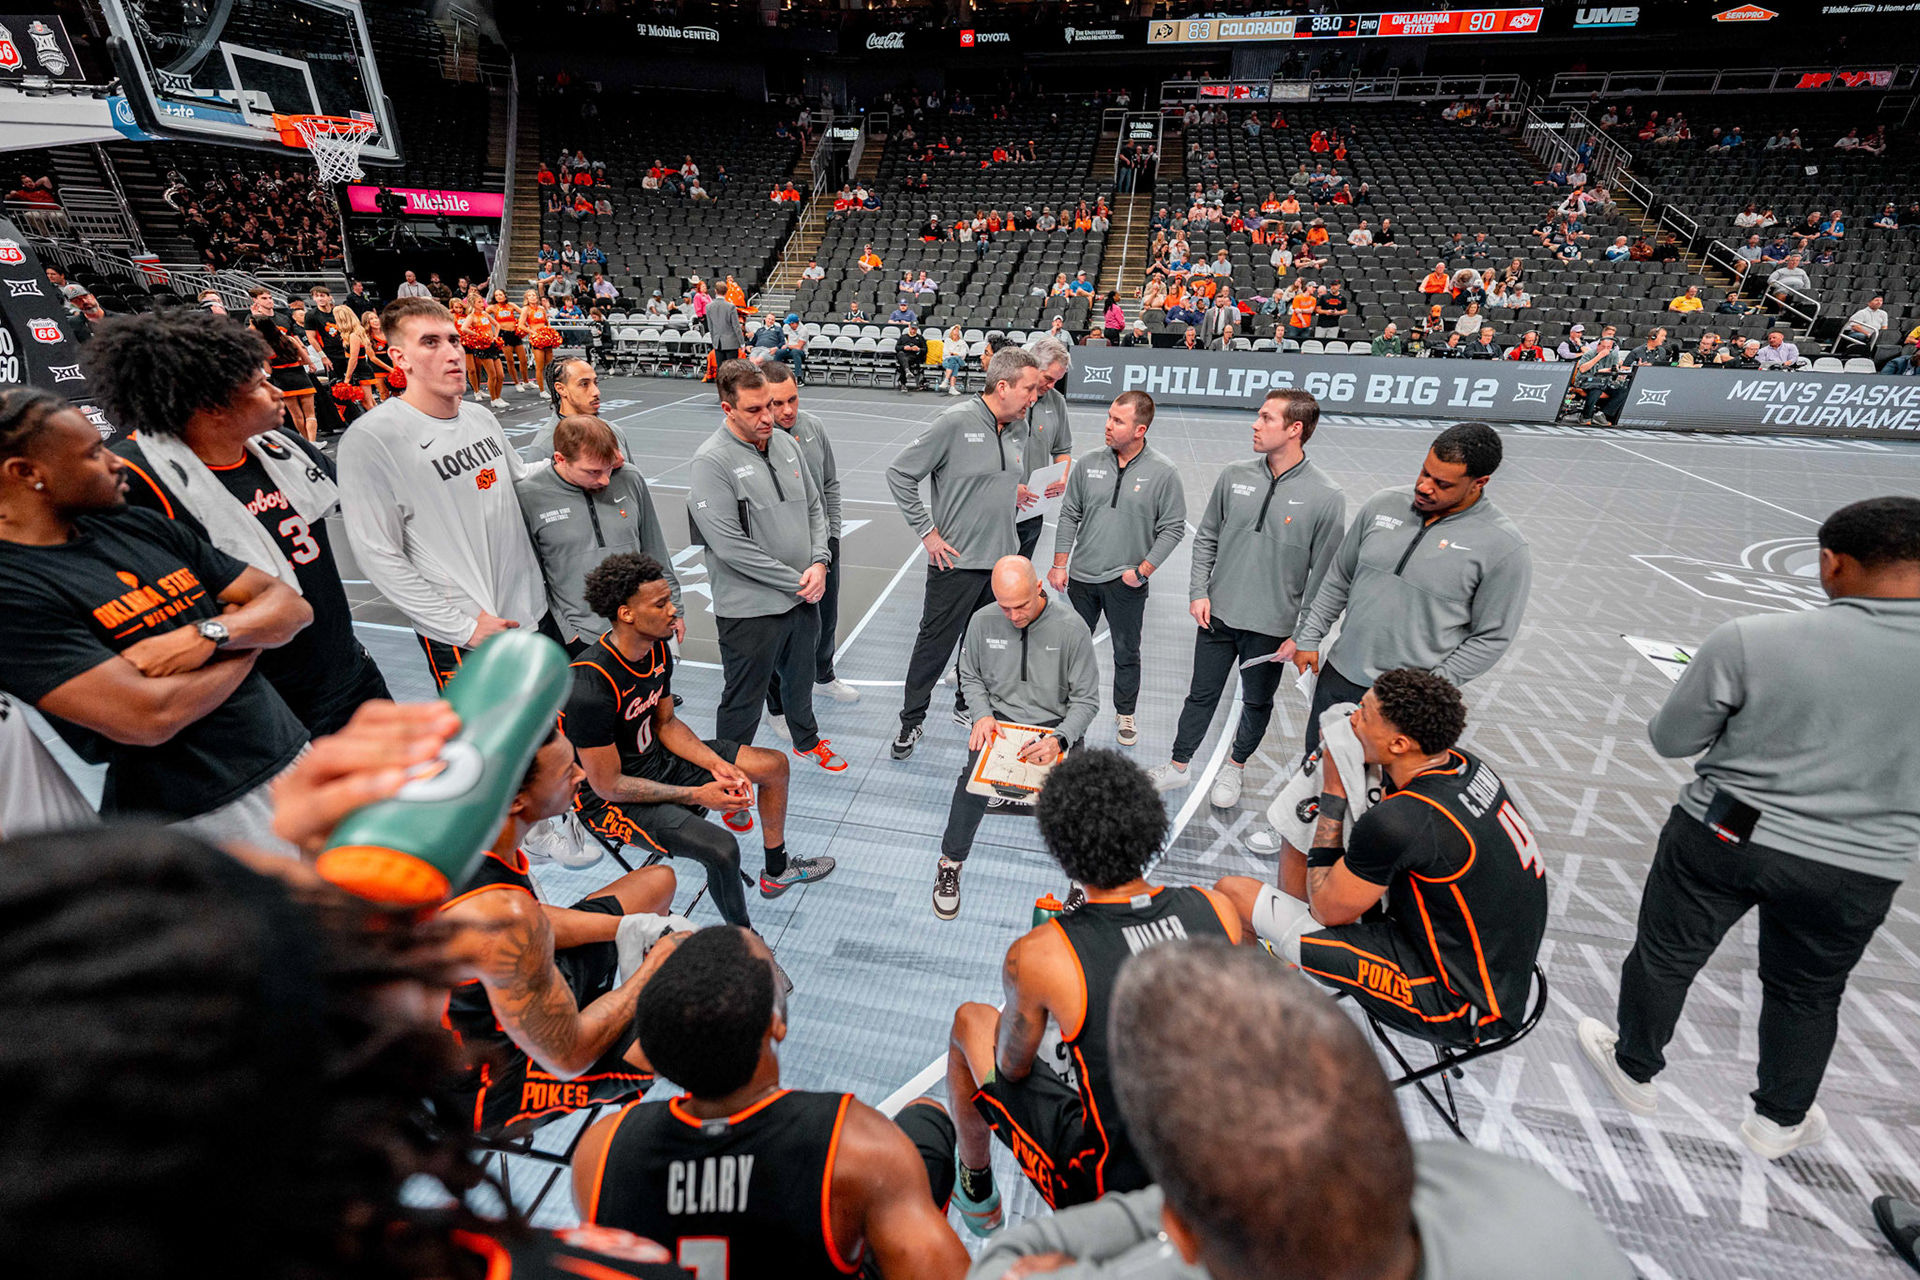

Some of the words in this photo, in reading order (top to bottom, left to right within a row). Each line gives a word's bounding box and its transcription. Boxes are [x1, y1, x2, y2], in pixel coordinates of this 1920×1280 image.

[1574, 7, 1640, 25] UMB
[1725, 10, 1764, 20] SERVPRO
[1828, 5, 1850, 14] Mobile
[1883, 4, 1905, 12] Home
[1905, 3, 1914, 11] of
[1188, 22, 1210, 40] 83
[1219, 20, 1293, 37] COLORADO
[1311, 16, 1342, 32] 38.0
[1360, 20, 1378, 30] 2ND
[1391, 13, 1450, 26] OKLAHOMA
[1469, 12, 1497, 31] 90
[1402, 24, 1435, 35] STATE
[647, 24, 682, 38] Mobile
[682, 29, 717, 41] CENTER
[976, 33, 1011, 43] TOYOTA
[1129, 131, 1152, 139] CENTER
[1135, 121, 1154, 130] Mobile
[410, 192, 470, 212] Mobile
[38, 328, 56, 340] 66
[1122, 364, 1294, 398] PHILLIPS
[1303, 371, 1357, 400] 66
[1364, 374, 1442, 405] BIG
[1447, 377, 1500, 408] 12
[1726, 380, 1823, 403] MEN'S
[1760, 404, 1920, 430] TOURNAME
[431, 446, 481, 482] LOCK
[472, 440, 494, 464] IT
[483, 436, 503, 458] IN
[475, 468, 498, 490] OSU
[637, 715, 653, 754] 0
[1496, 800, 1546, 879] 4
[1357, 958, 1414, 1006] POKES
[519, 1081, 589, 1111] POKES
[667, 1154, 755, 1216] CLARY
